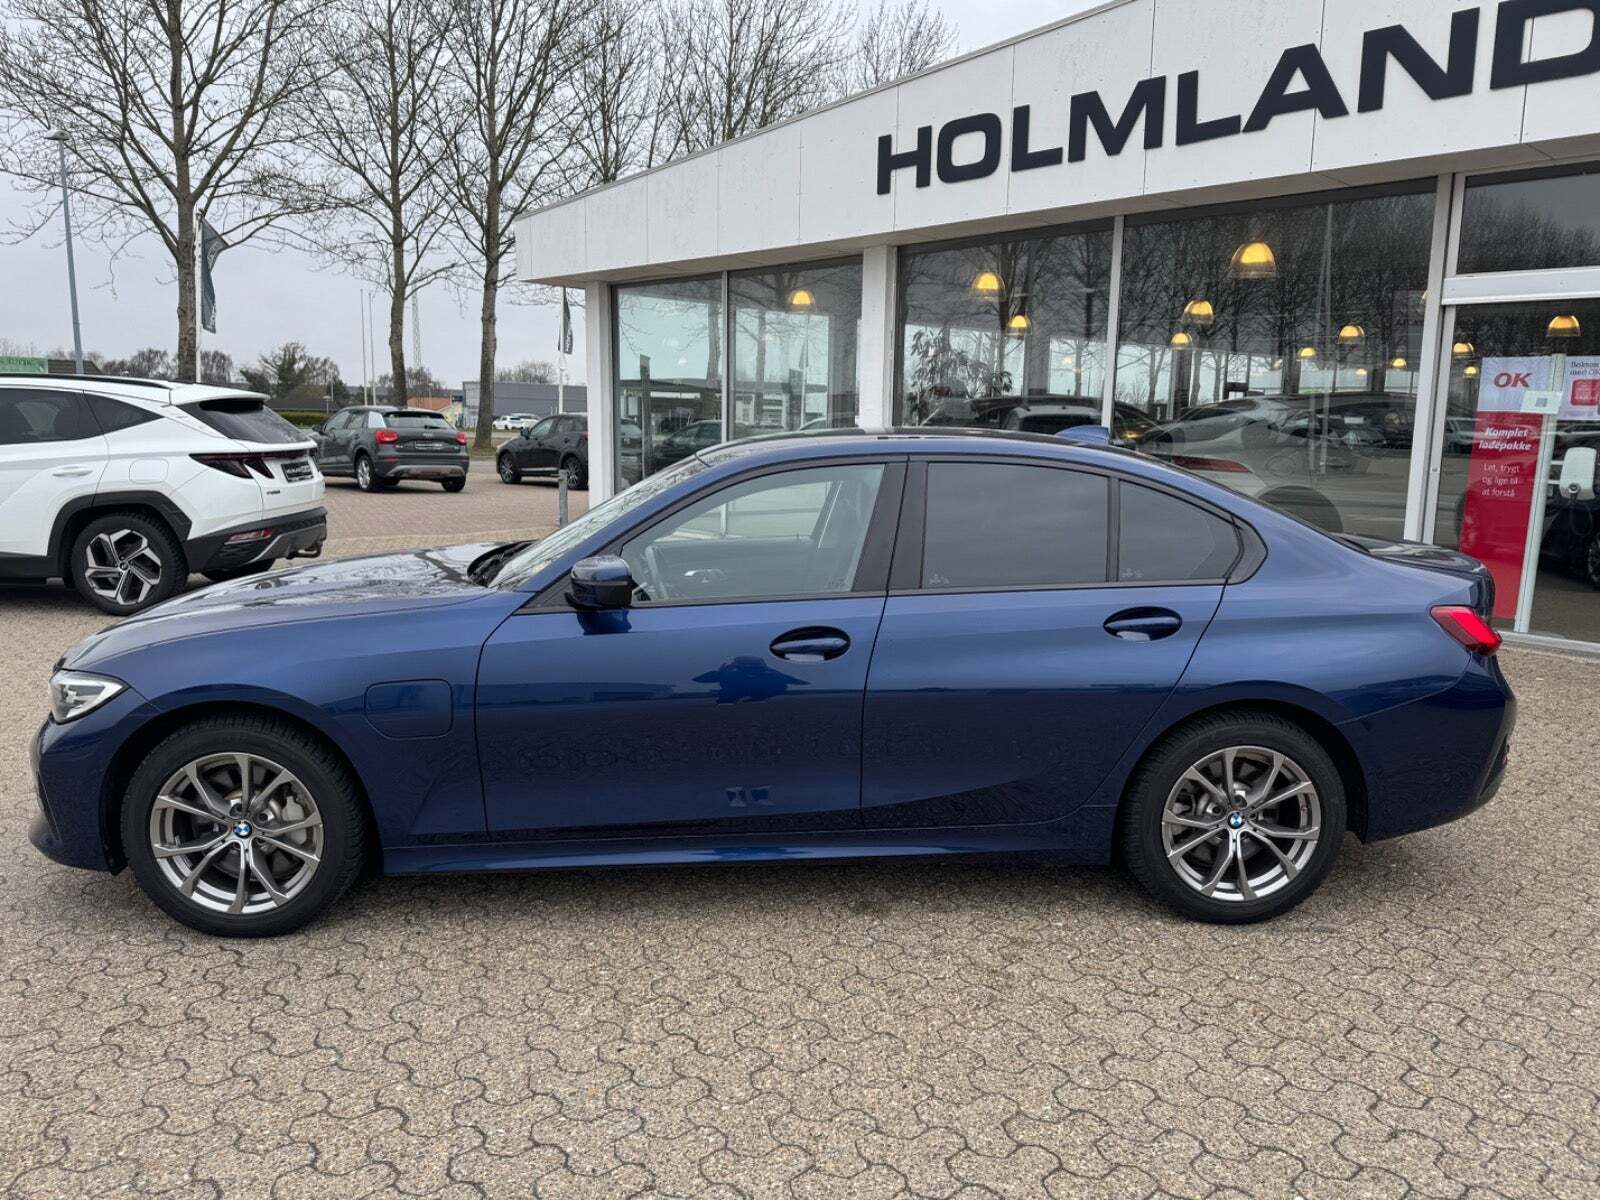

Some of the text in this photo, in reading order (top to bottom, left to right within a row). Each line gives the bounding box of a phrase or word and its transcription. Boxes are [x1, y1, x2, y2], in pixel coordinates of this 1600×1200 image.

[876, 0, 1600, 195] HOLMLAND
[1493, 372, 1533, 388] OK
[1484, 427, 1529, 438] Komplet
[1478, 439, 1532, 452] ladepakke
[1483, 463, 1520, 474] Let, trygt
[1491, 488, 1515, 497] forstå
